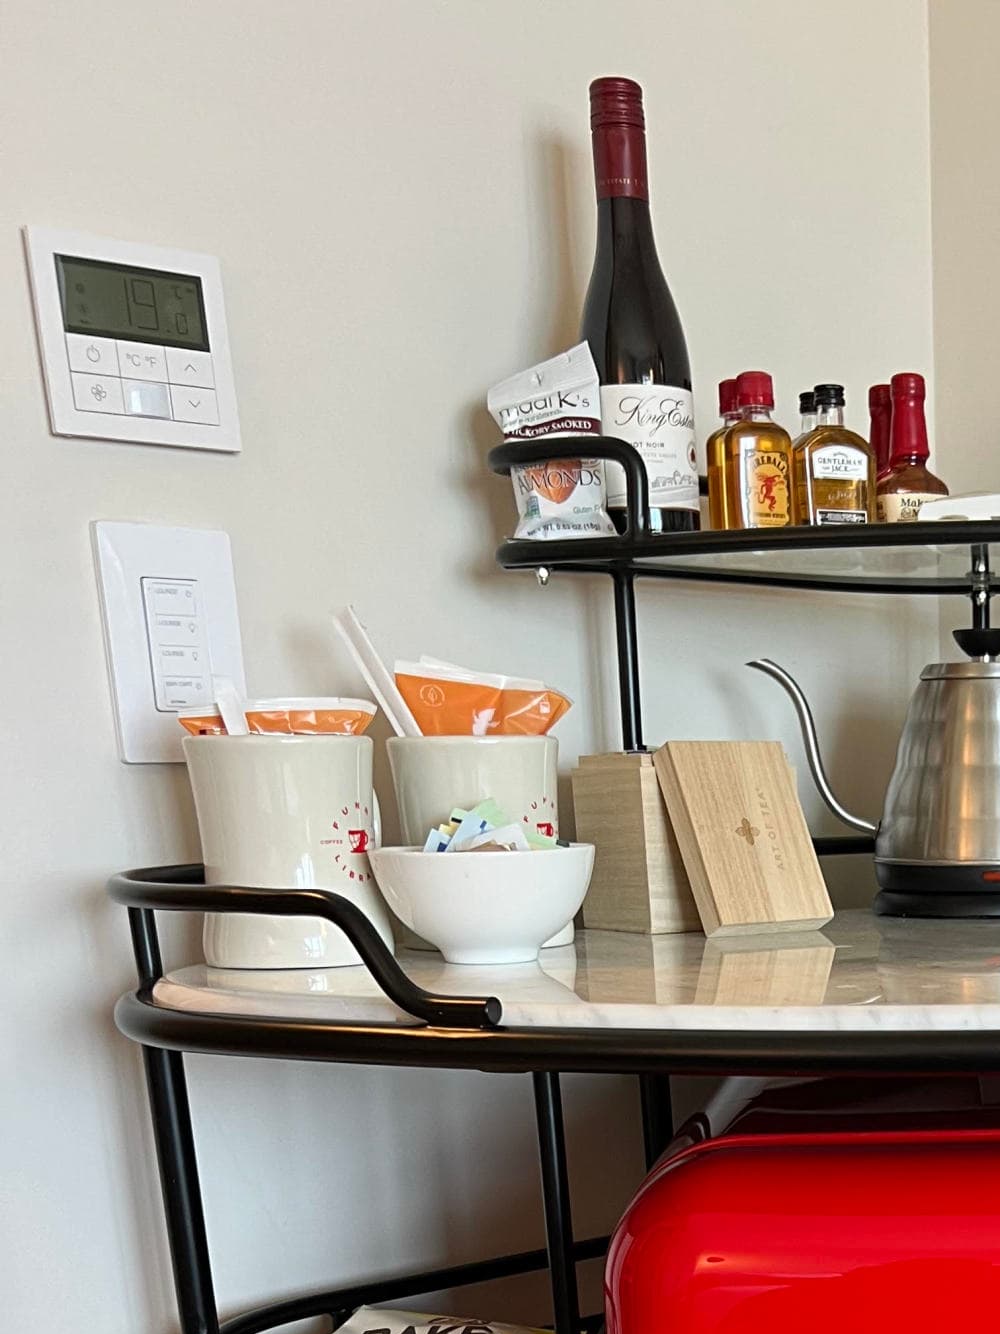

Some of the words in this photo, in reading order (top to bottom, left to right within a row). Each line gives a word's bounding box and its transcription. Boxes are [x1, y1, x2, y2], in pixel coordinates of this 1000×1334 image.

[551, 419, 592, 430] SMOKED
[817, 456, 863, 466] GENTLEMAN
[517, 468, 602, 495] ALMONDS
